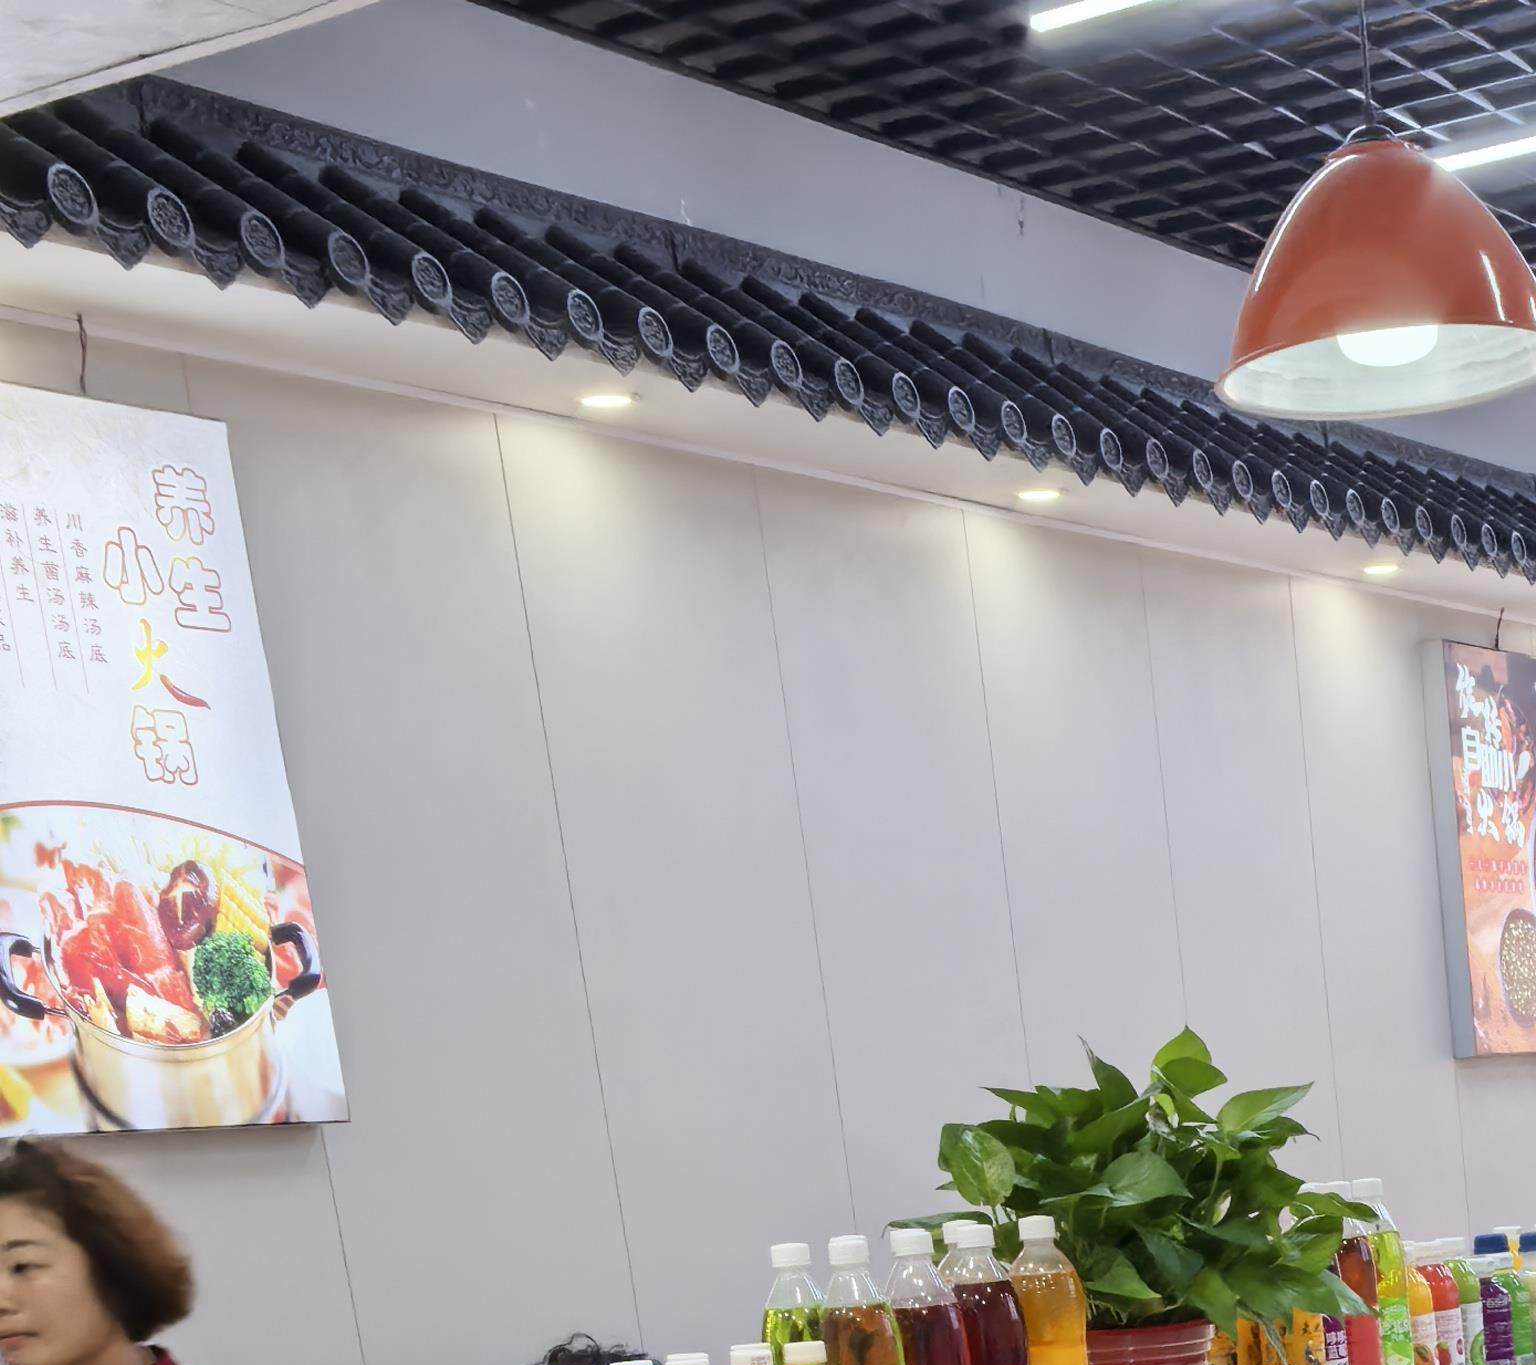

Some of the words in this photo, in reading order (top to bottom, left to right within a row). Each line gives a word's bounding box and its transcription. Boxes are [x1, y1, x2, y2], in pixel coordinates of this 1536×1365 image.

[33, 506, 76, 660] 养生菌汤汤底
[66, 512, 109, 663] 川香麻辣汤底
[152, 464, 232, 633] 养生
[103, 526, 212, 786] 小火锅
